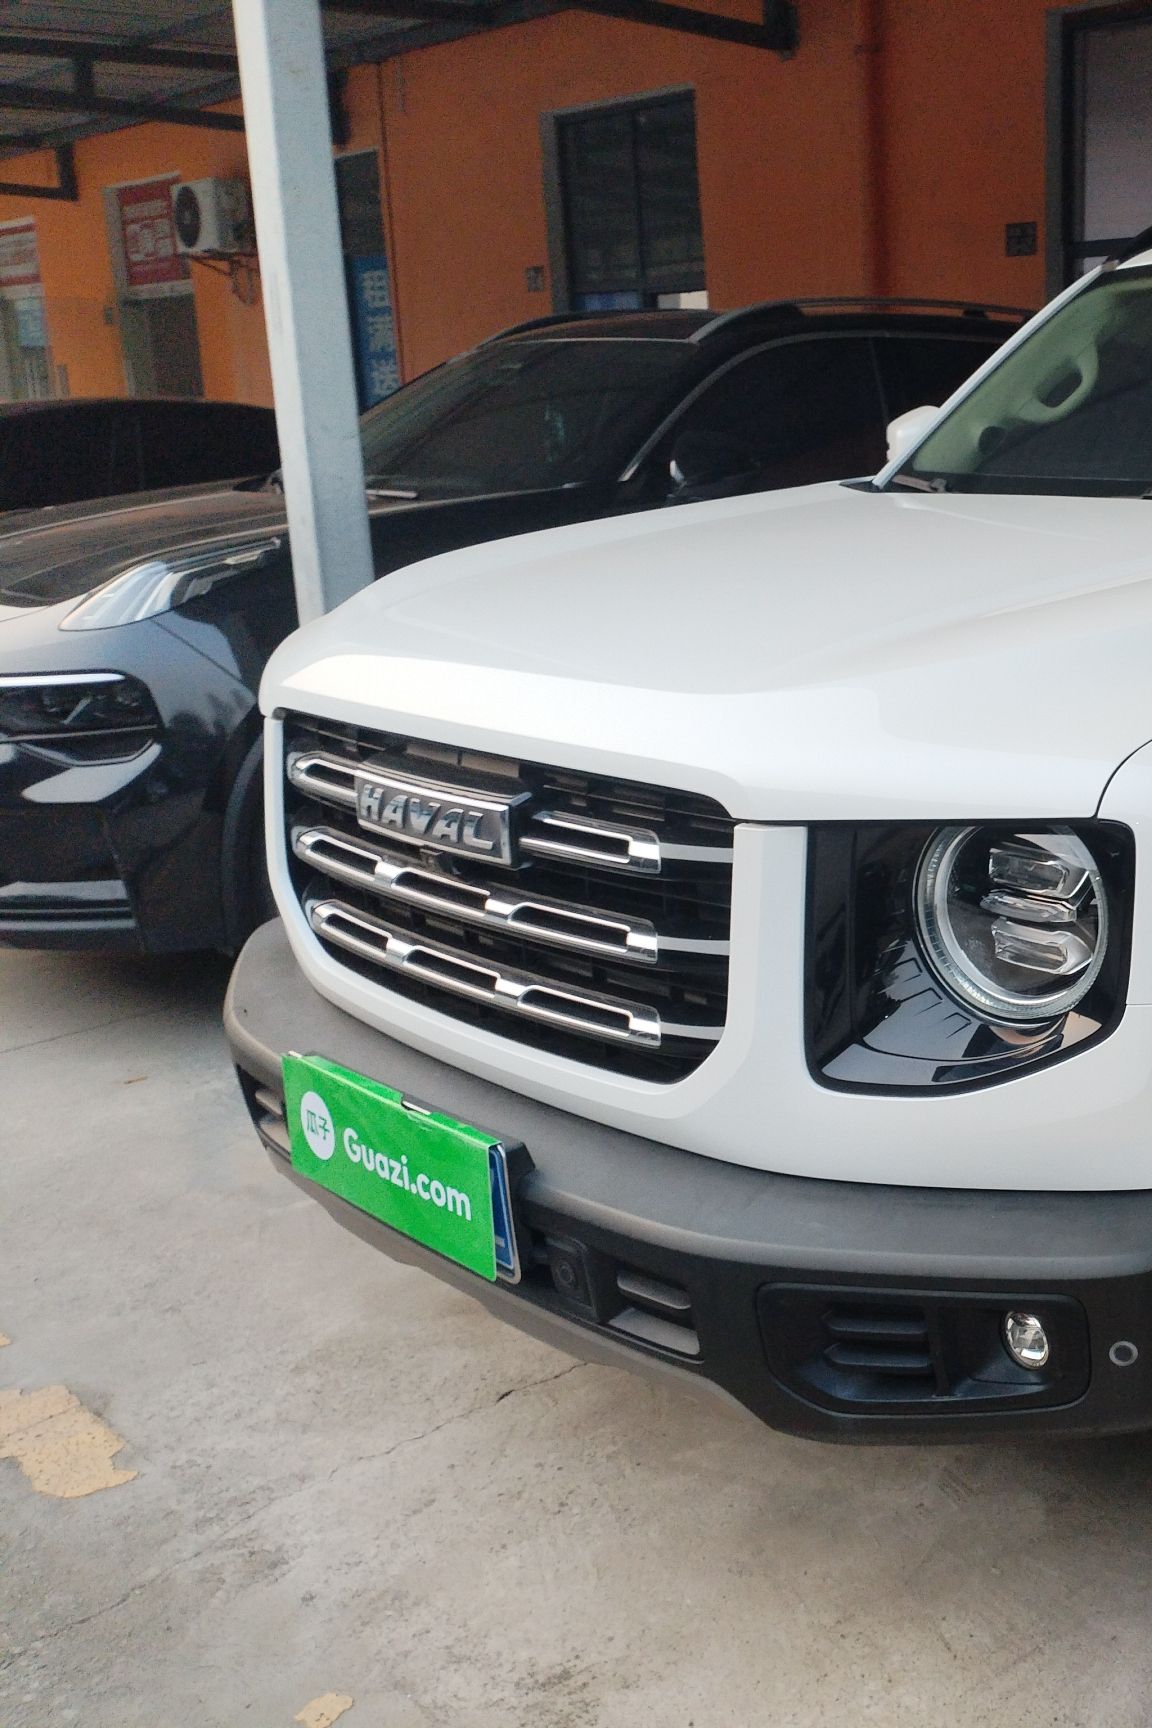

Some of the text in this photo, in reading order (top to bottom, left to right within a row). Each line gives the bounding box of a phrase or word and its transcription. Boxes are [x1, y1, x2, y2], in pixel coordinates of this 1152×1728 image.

[359, 784, 496, 851] HAVAL
[306, 1109, 330, 1140] 瓜子
[343, 1127, 472, 1222] Guazi.com
